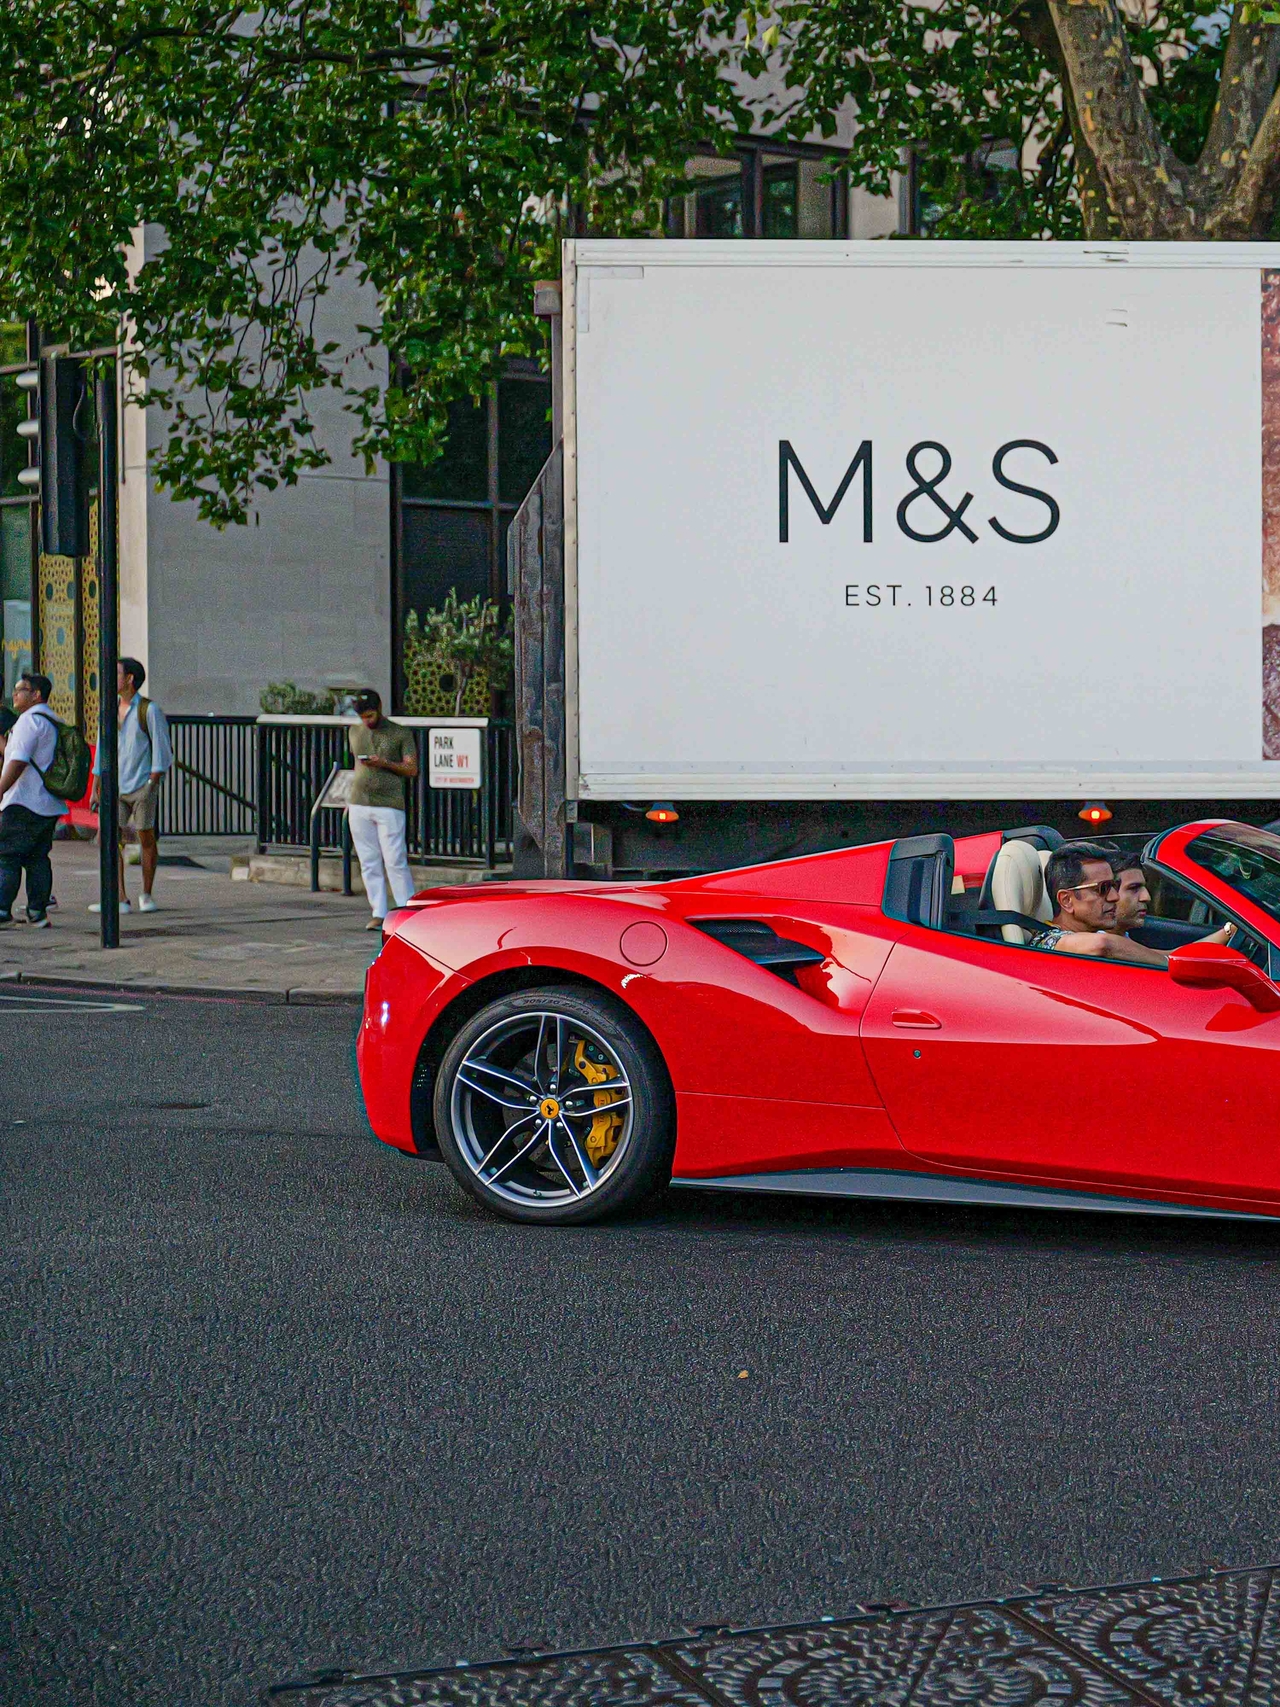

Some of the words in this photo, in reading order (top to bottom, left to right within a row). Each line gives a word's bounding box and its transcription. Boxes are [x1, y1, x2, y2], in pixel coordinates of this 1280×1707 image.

[779, 439, 1060, 544] M&S
[845, 584, 912, 607] EST.
[925, 585, 998, 607] 1884
[434, 735, 454, 750] PARK
[434, 754, 454, 768] LANE
[456, 754, 470, 768] W1
